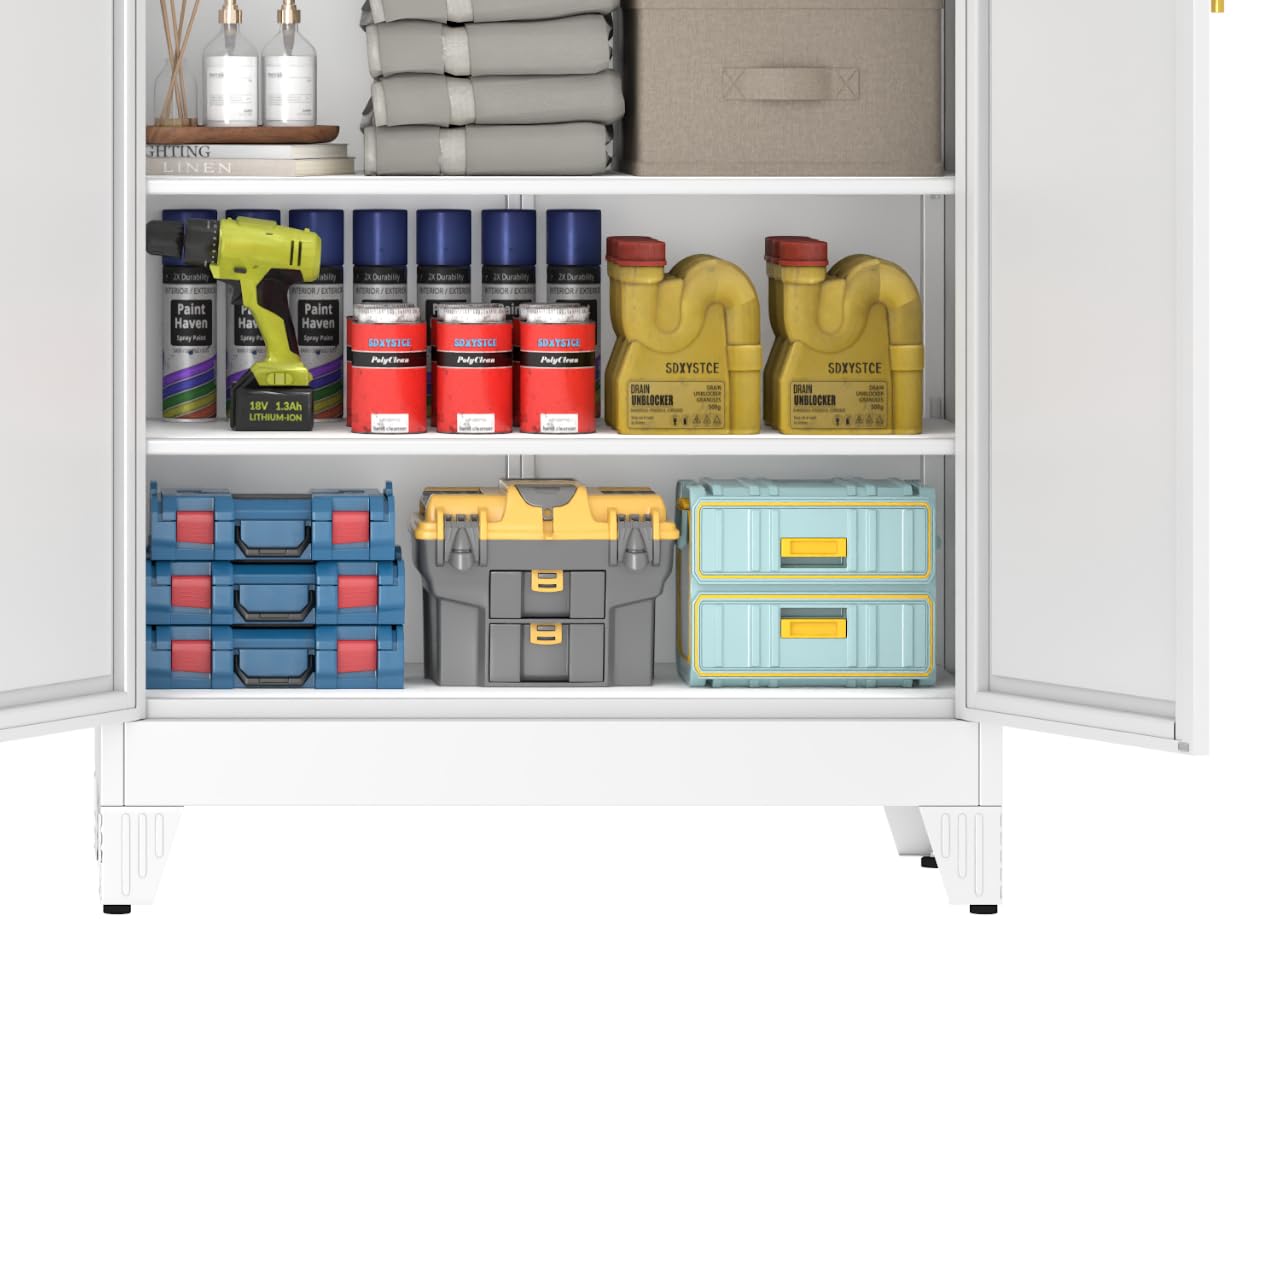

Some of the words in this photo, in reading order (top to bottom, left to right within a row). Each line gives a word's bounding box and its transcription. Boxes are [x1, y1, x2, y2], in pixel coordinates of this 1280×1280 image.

[163, 162, 232, 174] LINEN
[177, 302, 206, 315] Paint
[304, 303, 333, 316] Paint
[174, 317, 208, 329] Haven
[238, 317, 257, 329] Hav
[302, 318, 334, 329] Haven
[371, 356, 410, 365] PolyClean
[457, 356, 496, 365] PolyClean
[540, 356, 579, 365] PolyClean
[666, 362, 720, 374] SDXYSTCE
[828, 362, 882, 374] SDXYSTCE
[631, 384, 650, 394] DRAIN
[793, 384, 812, 394] DRAIN
[250, 401, 268, 410] 18V
[276, 401, 302, 410] 1.3Ah
[632, 395, 673, 406] UNBLOCKER
[794, 395, 836, 406] UNBLOCKER
[249, 414, 302, 422] LITHIUM-ION
